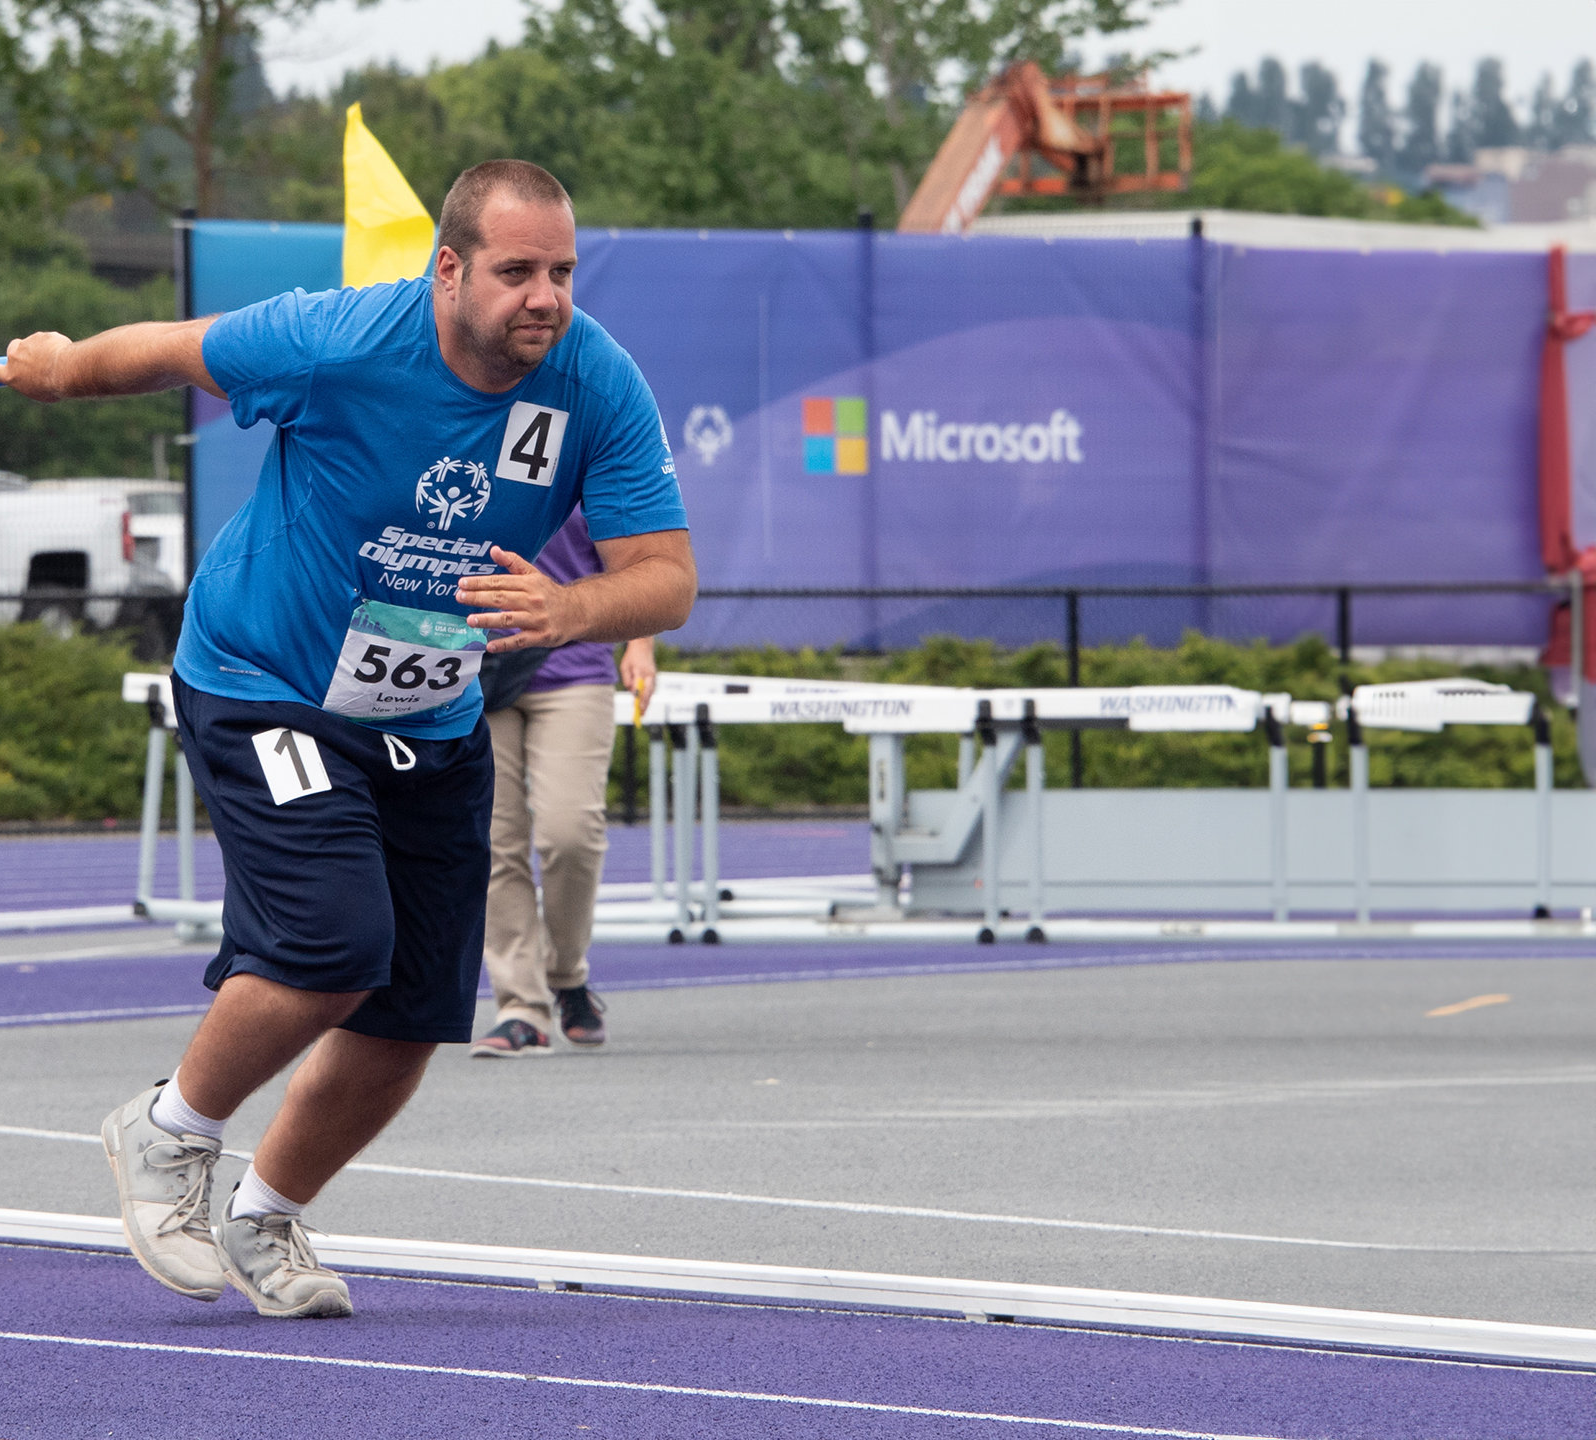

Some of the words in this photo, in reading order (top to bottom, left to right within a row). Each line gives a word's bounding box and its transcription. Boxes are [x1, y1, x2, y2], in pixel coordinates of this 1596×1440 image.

[509, 411, 553, 480] 4
[879, 408, 1085, 463] Microsoft
[358, 541, 498, 577] Olympics
[378, 525, 493, 557] Special
[378, 571, 423, 592] New
[425, 578, 462, 597] Yor
[353, 643, 463, 691] 563
[376, 691, 421, 704] Lewis
[769, 699, 912, 718] WASHINGTON
[274, 728, 313, 791] 1
